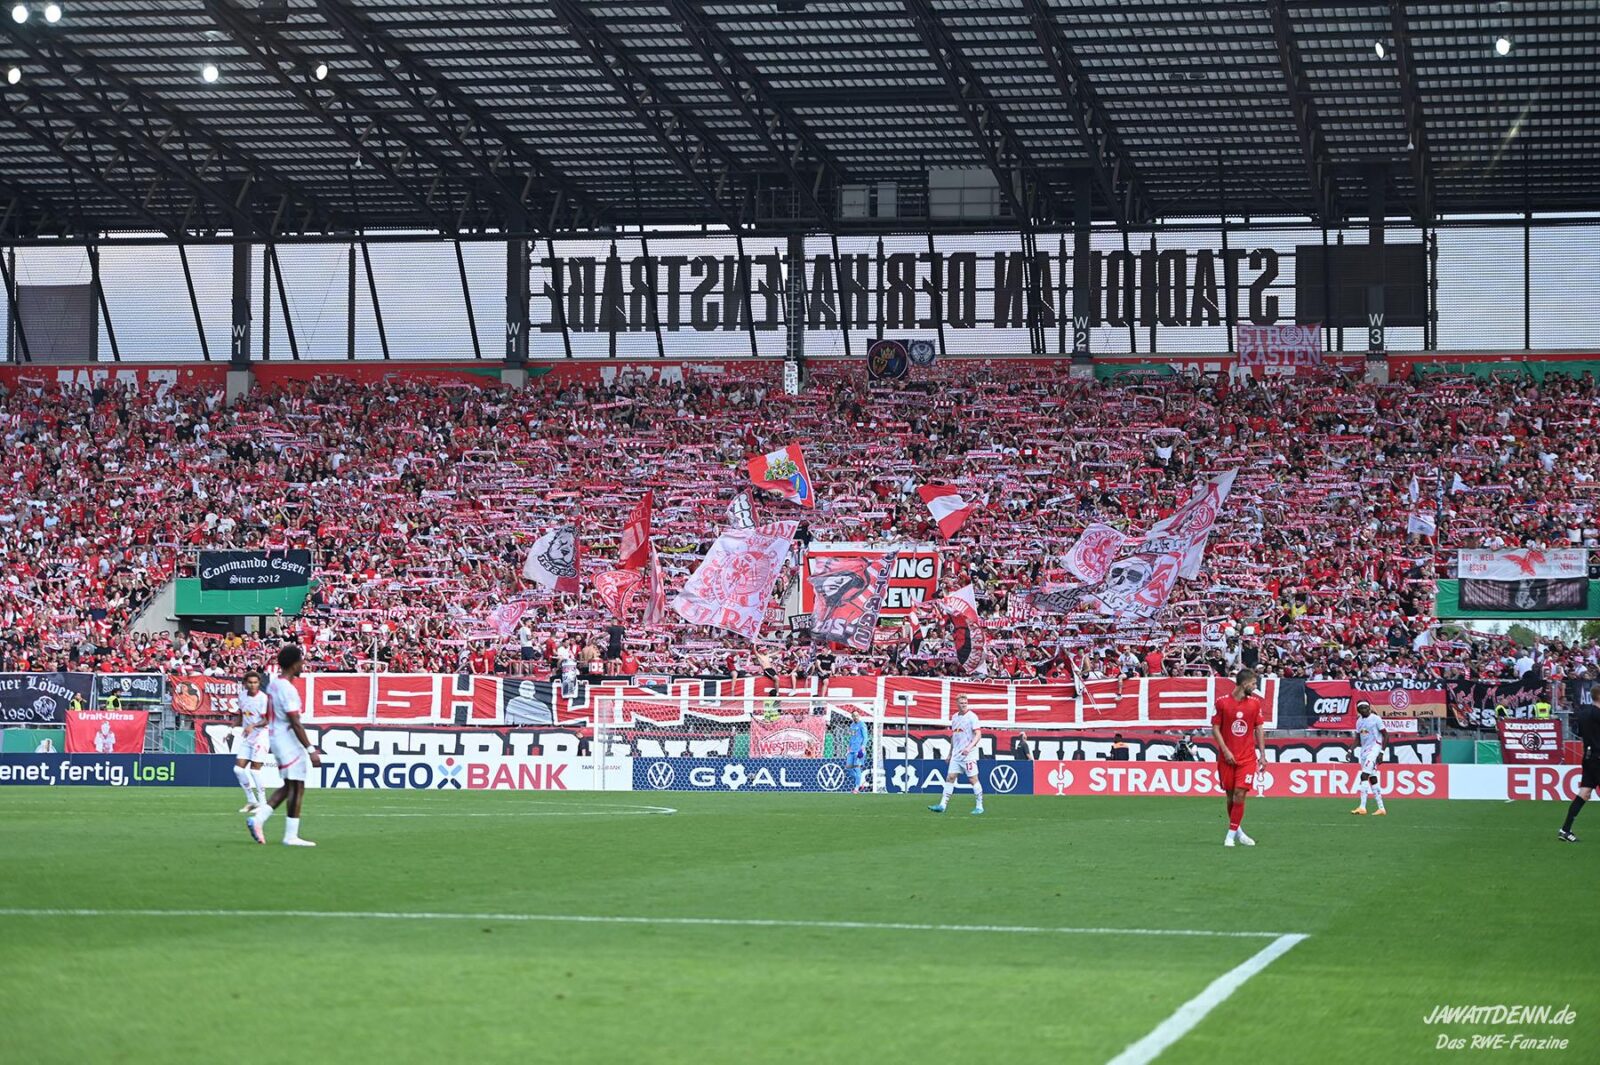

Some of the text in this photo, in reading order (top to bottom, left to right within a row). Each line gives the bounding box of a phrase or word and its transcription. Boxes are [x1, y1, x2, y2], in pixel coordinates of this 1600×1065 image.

[1238, 345, 1322, 366] KASTEN
[202, 556, 306, 580] Commando Essen
[229, 574, 280, 585] Since 2012
[26, 675, 75, 701] Löwen
[78, 712, 135, 721] Uralt-Ultras
[1313, 697, 1350, 715] CREW
[0, 760, 175, 786] enet, fertig, los!
[1089, 767, 1227, 793] STRAUSS
[1289, 768, 1436, 796] STRAUSS
[1507, 766, 1600, 801] ERG
